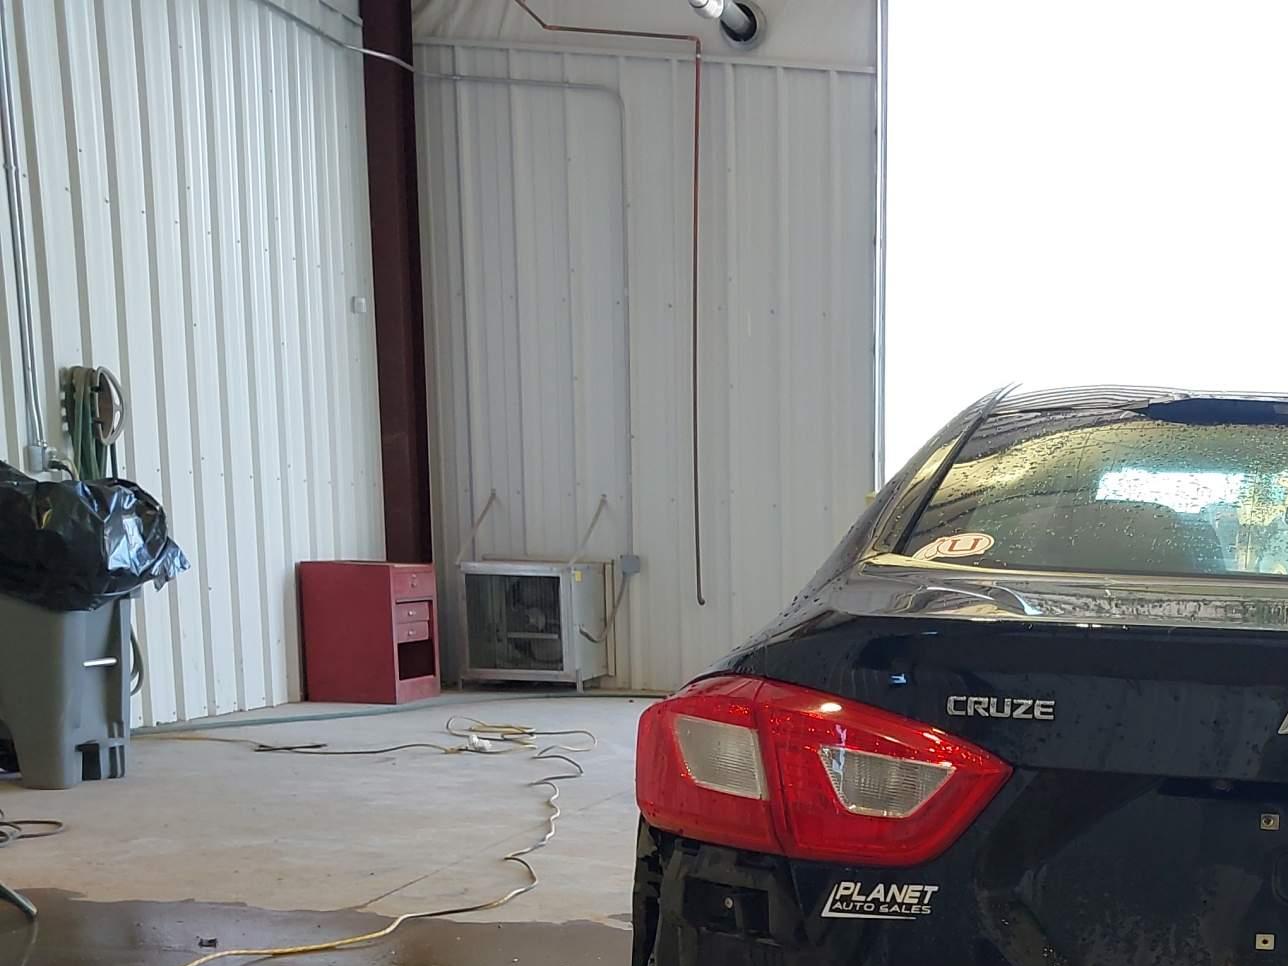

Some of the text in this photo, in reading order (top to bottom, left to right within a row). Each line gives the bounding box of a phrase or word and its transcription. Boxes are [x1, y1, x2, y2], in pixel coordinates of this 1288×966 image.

[946, 695, 1055, 720] CRUZE
[835, 881, 939, 904] PLANET
[832, 901, 932, 914] AUTO SALES
